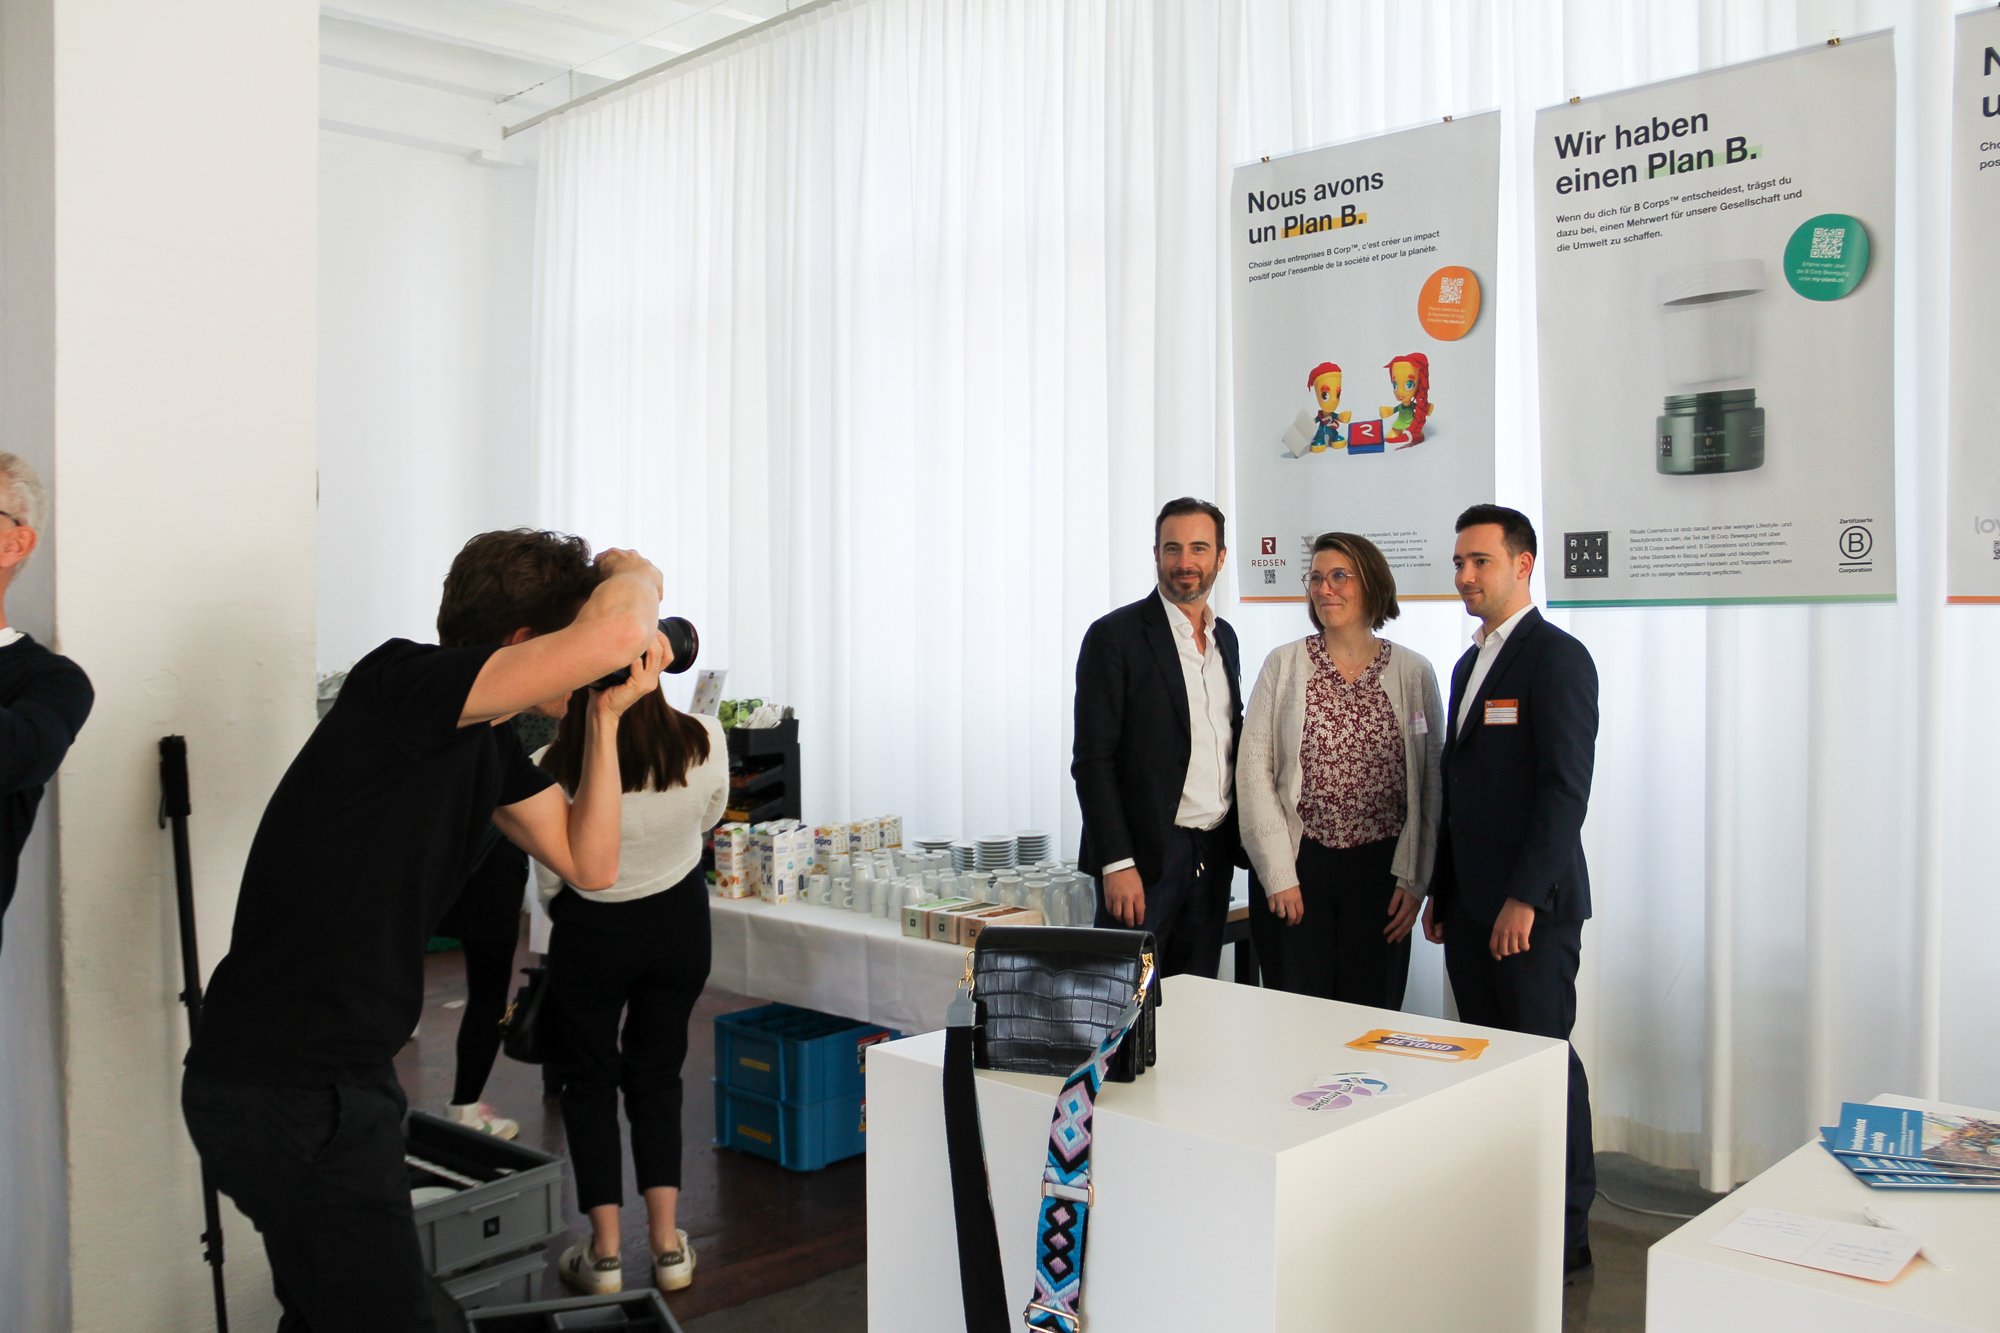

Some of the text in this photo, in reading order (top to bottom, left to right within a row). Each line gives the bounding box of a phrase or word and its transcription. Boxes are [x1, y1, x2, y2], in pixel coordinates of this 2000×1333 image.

[1554, 112, 1708, 159] Wir haben
[1556, 136, 1757, 195] einen Plan B.
[1248, 172, 1384, 213] Nous avons
[1556, 214, 1581, 223] Wenn
[1584, 212, 1595, 220] du
[1598, 208, 1617, 218] dich
[1620, 206, 1632, 214] für
[1634, 203, 1640, 211] B
[1681, 184, 1744, 203] entscheidest,
[1747, 179, 1776, 191] trägst
[1779, 176, 1792, 185] du
[1249, 204, 1363, 244] un Plan B.
[1556, 189, 1802, 238] dazu bei, einen Mehrwert für unsere Gesellschaft und
[1248, 259, 1272, 269] Choisir
[1273, 257, 1286, 265] des
[1287, 250, 1325, 263] entreprises
[1326, 248, 1332, 256] B
[1362, 241, 1380, 250] c'est
[1381, 237, 1400, 246] créer
[1413, 230, 1440, 241] impact
[1556, 243, 1570, 252] die
[1573, 238, 1608, 250] Umwelt
[1623, 230, 1663, 243] schaffen.
[1248, 272, 1270, 283] positif
[1271, 270, 1286, 279] pour
[1288, 263, 1324, 275] l'ensemble
[1344, 256, 1370, 266] société
[1381, 252, 1397, 261] pour
[1408, 245, 1438, 257] planète.
[1848, 532, 1864, 553] B
[1251, 559, 1286, 567] REDSEN
[814, 836, 831, 847] alpro
[1383, 1038, 1453, 1051] BEYOND
